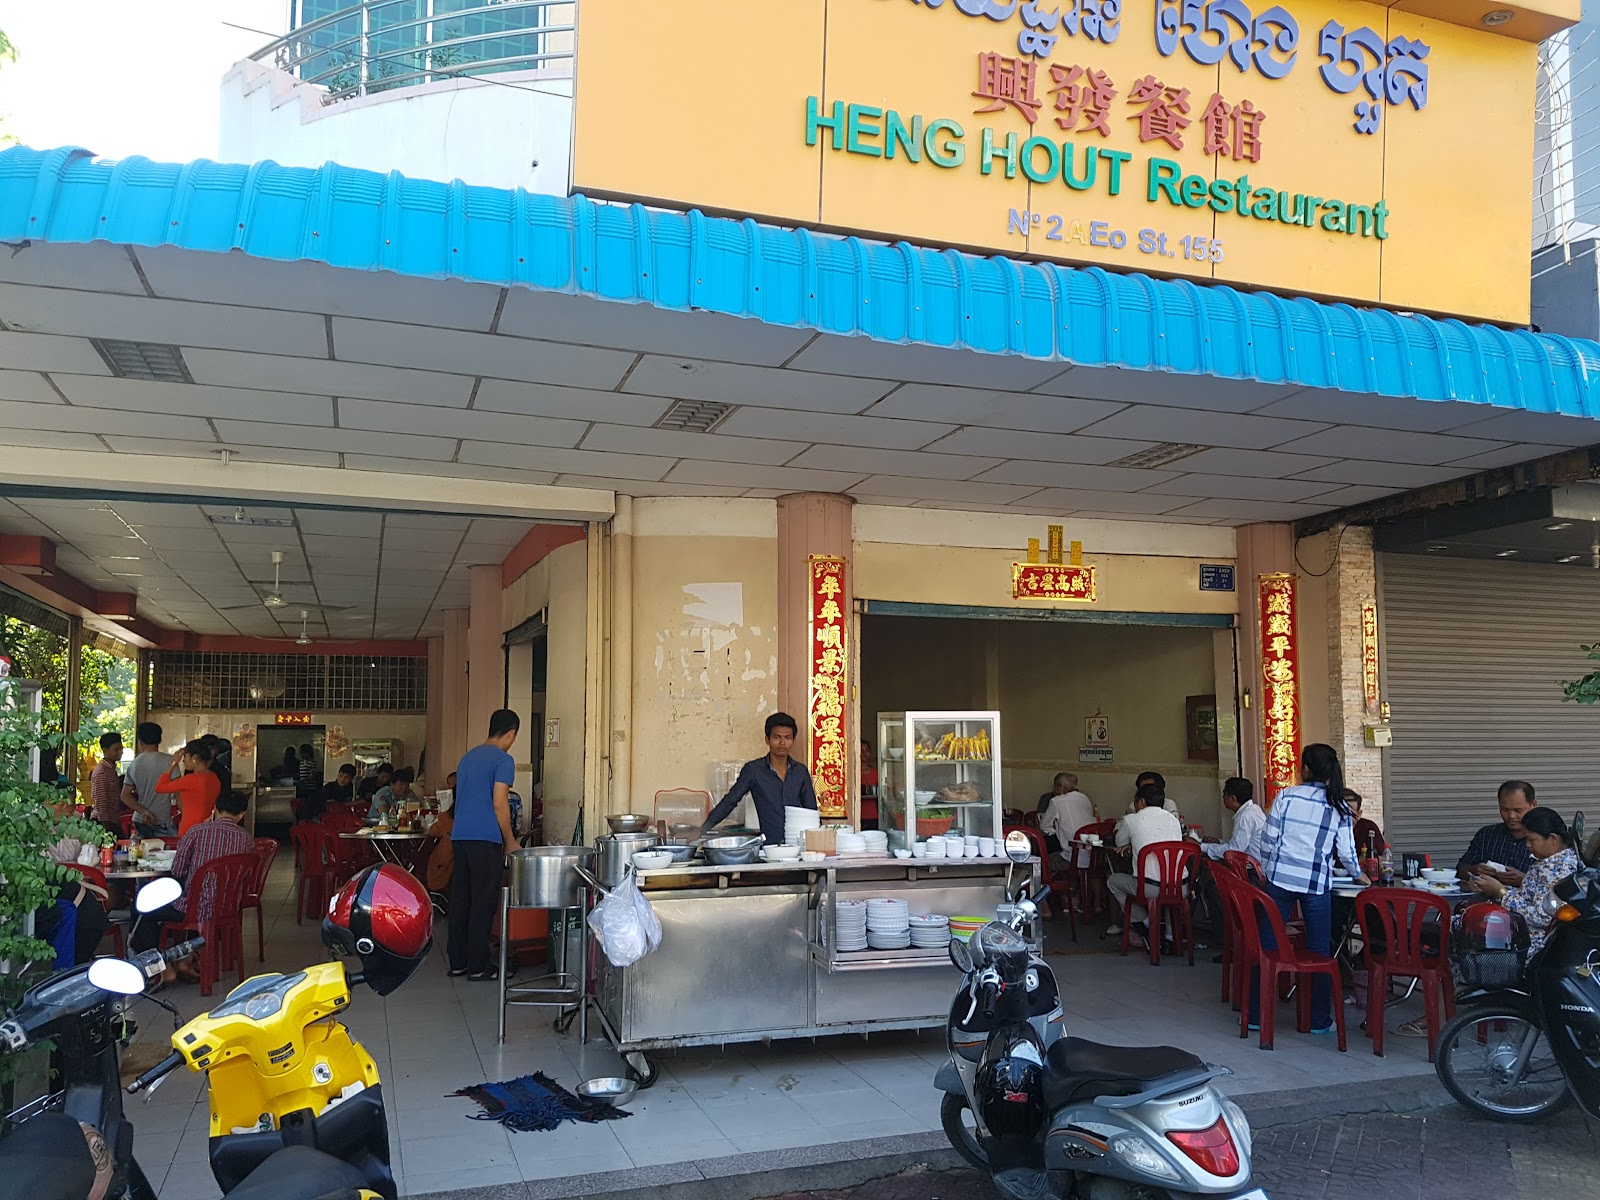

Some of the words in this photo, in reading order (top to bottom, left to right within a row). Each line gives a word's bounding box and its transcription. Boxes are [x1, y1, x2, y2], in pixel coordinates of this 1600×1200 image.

[971, 51, 1266, 163] 興發餐館
[806, 95, 965, 168] HENG
[980, 127, 1132, 196] HOUT
[1147, 156, 1389, 240] Restaurant
[1560, 1003, 1596, 1013] HONDA
[1178, 1094, 1204, 1106] SUZUKI
